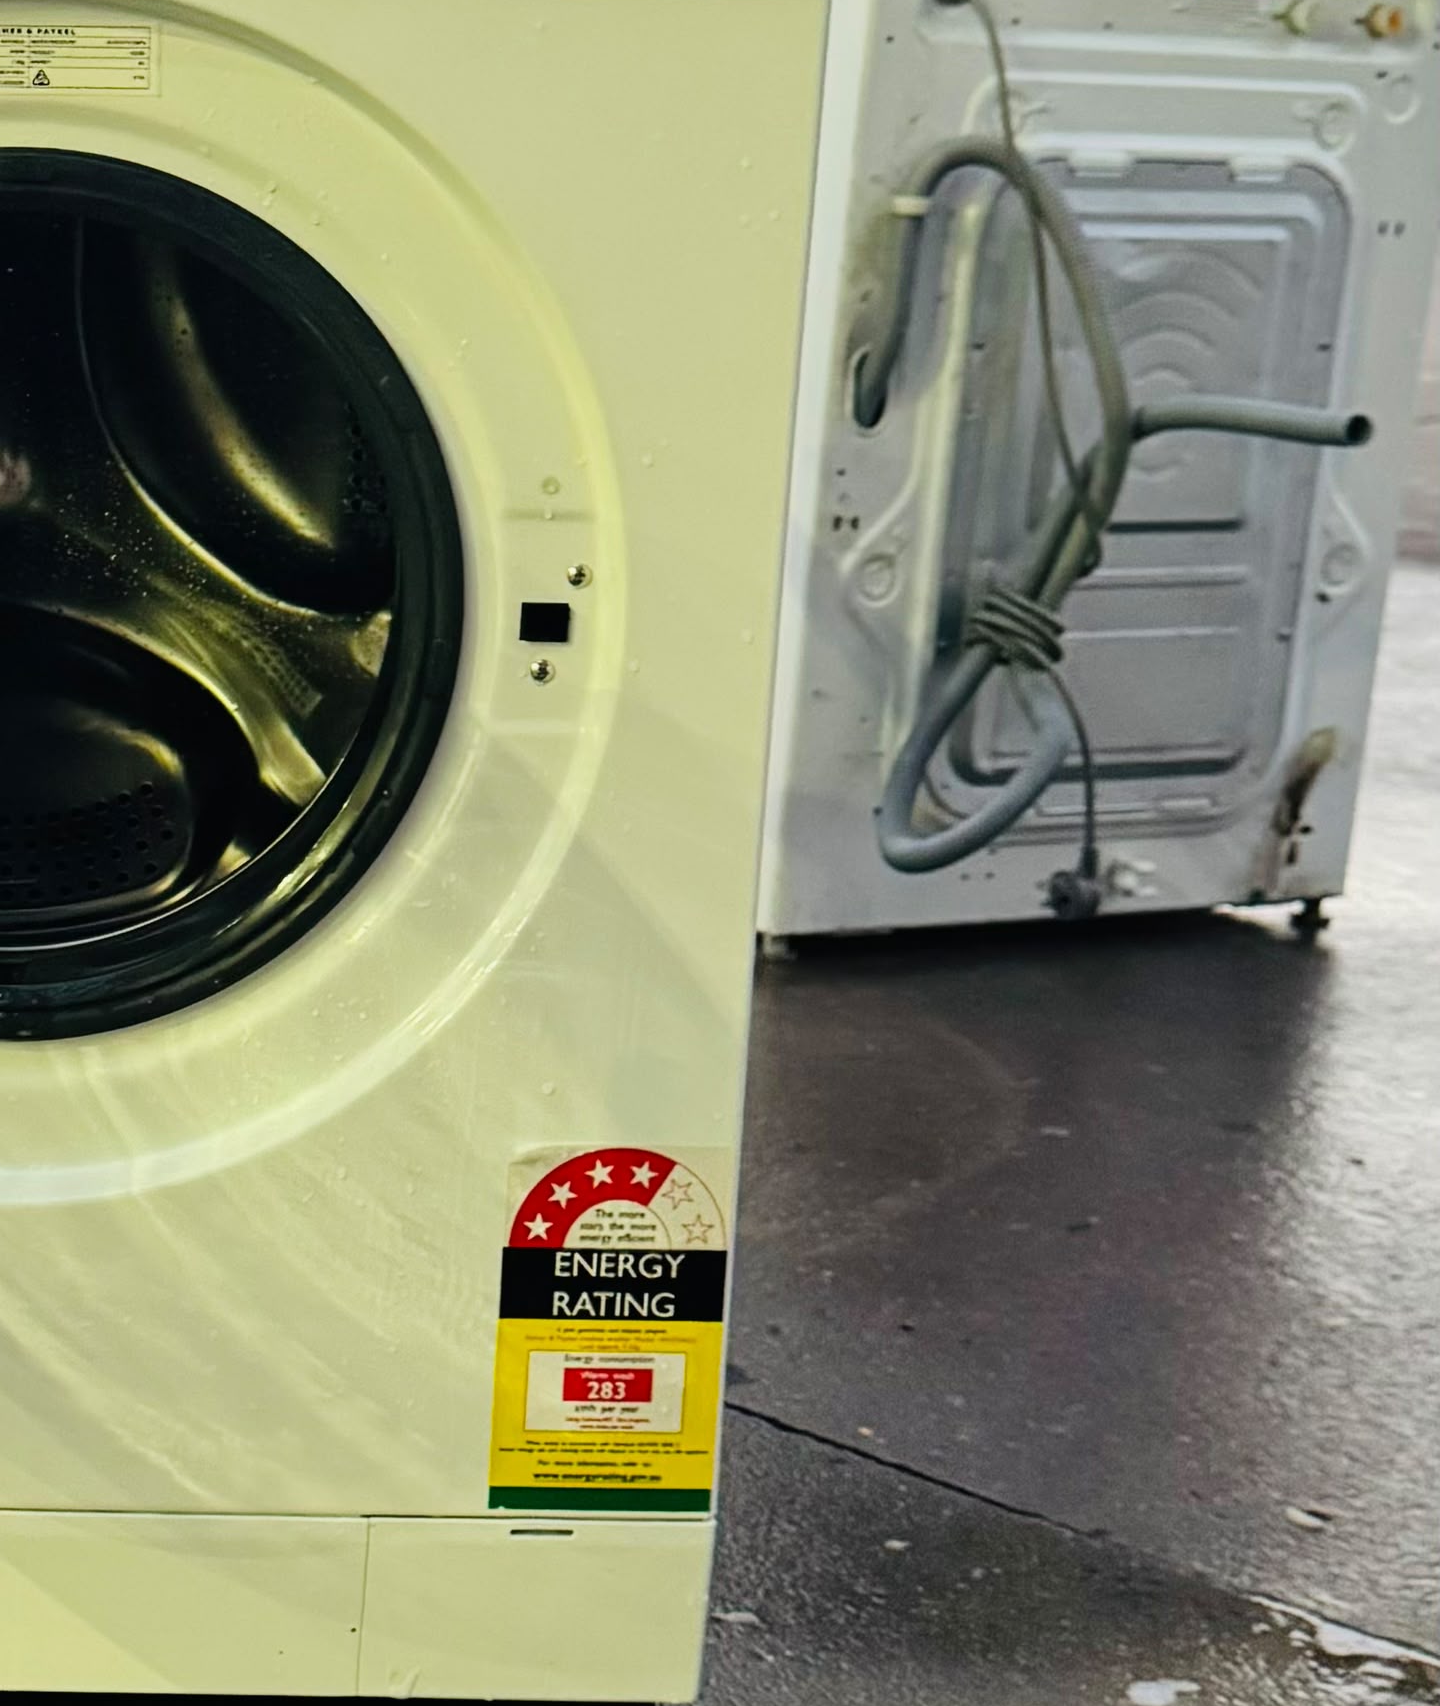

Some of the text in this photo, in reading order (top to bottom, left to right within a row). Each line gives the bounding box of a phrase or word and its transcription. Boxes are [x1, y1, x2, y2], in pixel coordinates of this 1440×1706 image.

[595, 1208, 614, 1219] The
[554, 1251, 686, 1279] ENERGY
[552, 1290, 676, 1318] RATING
[587, 1381, 627, 1400] 283
